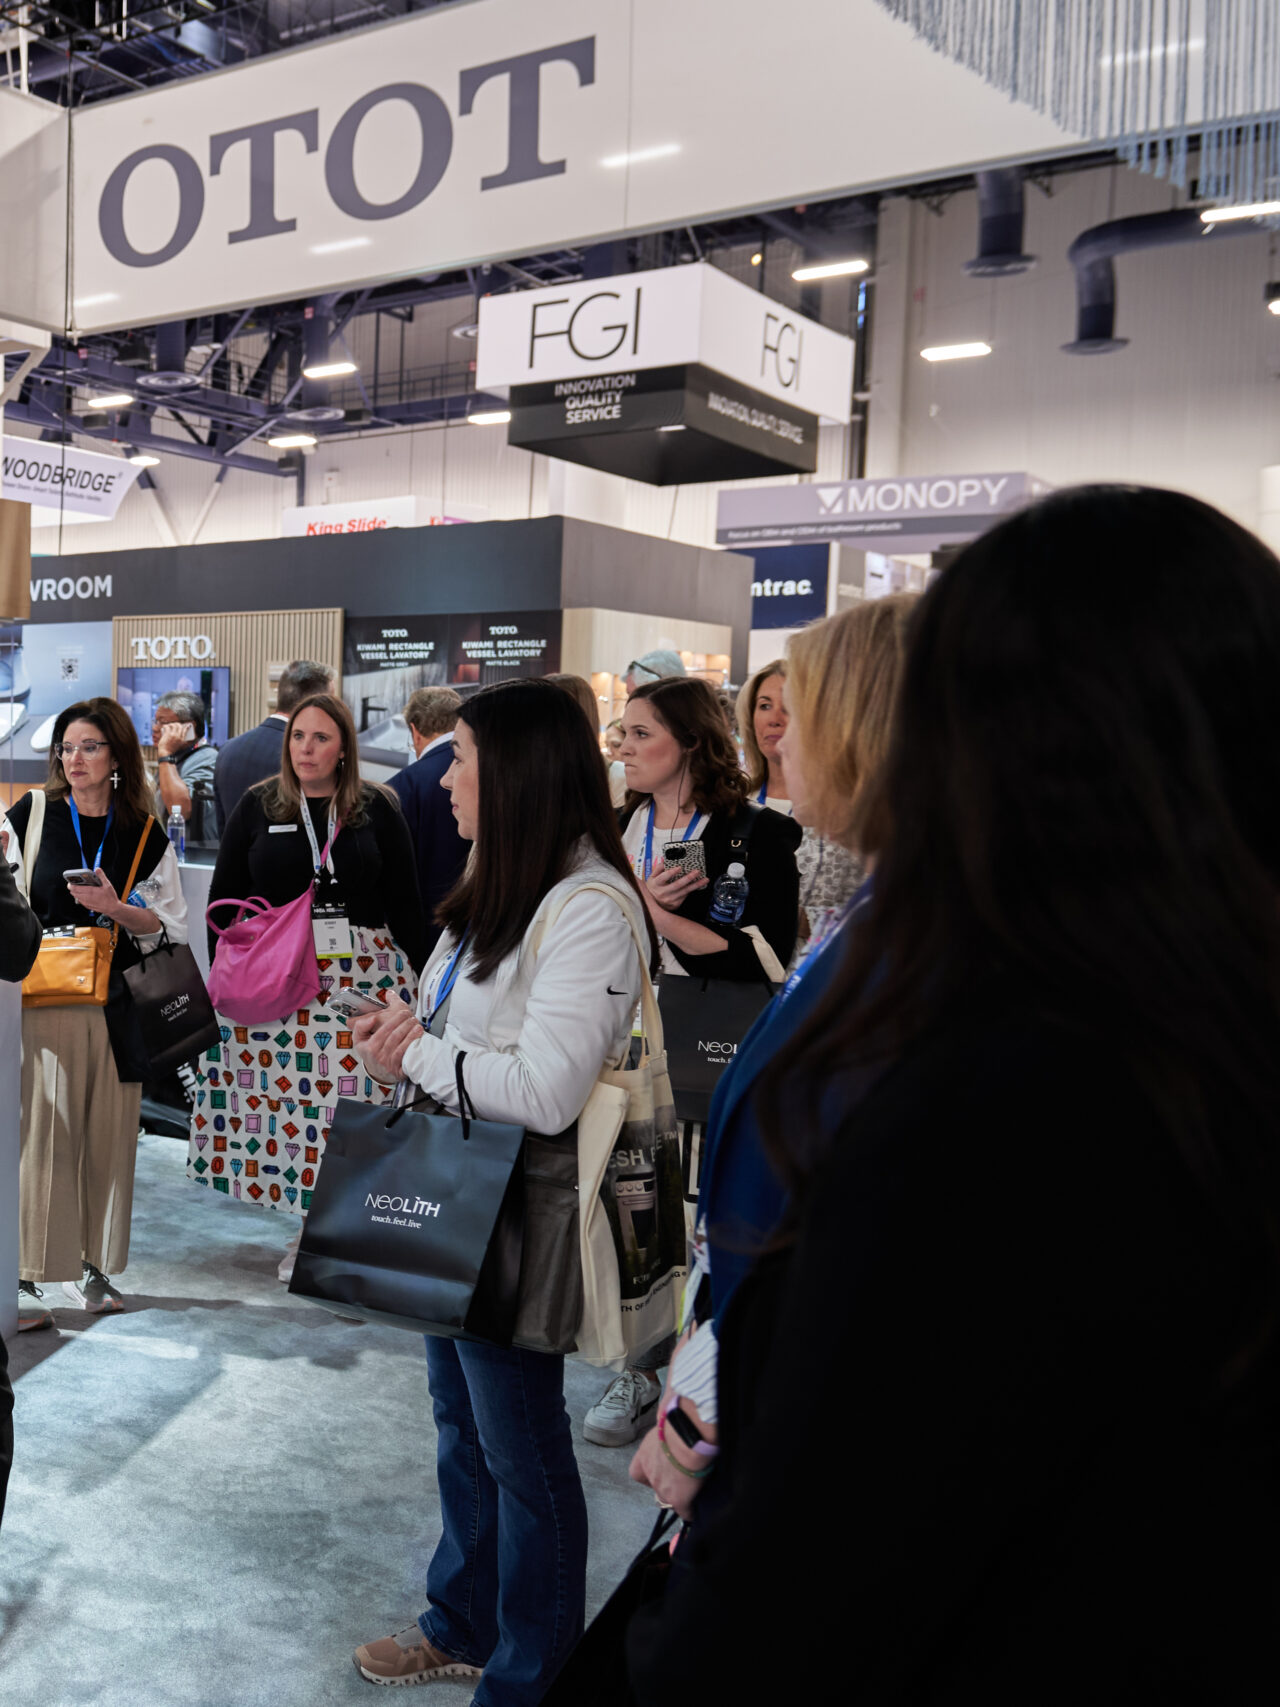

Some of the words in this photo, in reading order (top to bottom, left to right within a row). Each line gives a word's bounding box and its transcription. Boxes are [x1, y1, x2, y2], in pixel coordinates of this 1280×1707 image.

[98, 35, 596, 268] OTOT
[529, 287, 641, 369] FGI
[761, 312, 804, 392] FGI
[554, 374, 636, 396] INNOVATION
[565, 390, 623, 410] QUALITY
[565, 404, 622, 424] SERVICE
[2, 456, 115, 493] WOODBRIDGE
[847, 477, 1009, 513] MONOPY
[347, 517, 387, 532] Slide
[30, 575, 112, 601] ROOM
[750, 578, 812, 597] ntrac
[381, 629, 408, 638] TOTO
[489, 626, 518, 635] TOTO
[131, 635, 213, 661] TOTO
[356, 643, 386, 651] KIWAMI
[389, 642, 434, 651] RECTANGLE
[462, 640, 494, 649] KIWAMI
[497, 639, 547, 648] RECTANGLE
[466, 650, 497, 658] VESSEL
[498, 649, 542, 658] LAVATORY
[360, 651, 388, 660] VESSEL
[389, 651, 430, 660] LAVATORY
